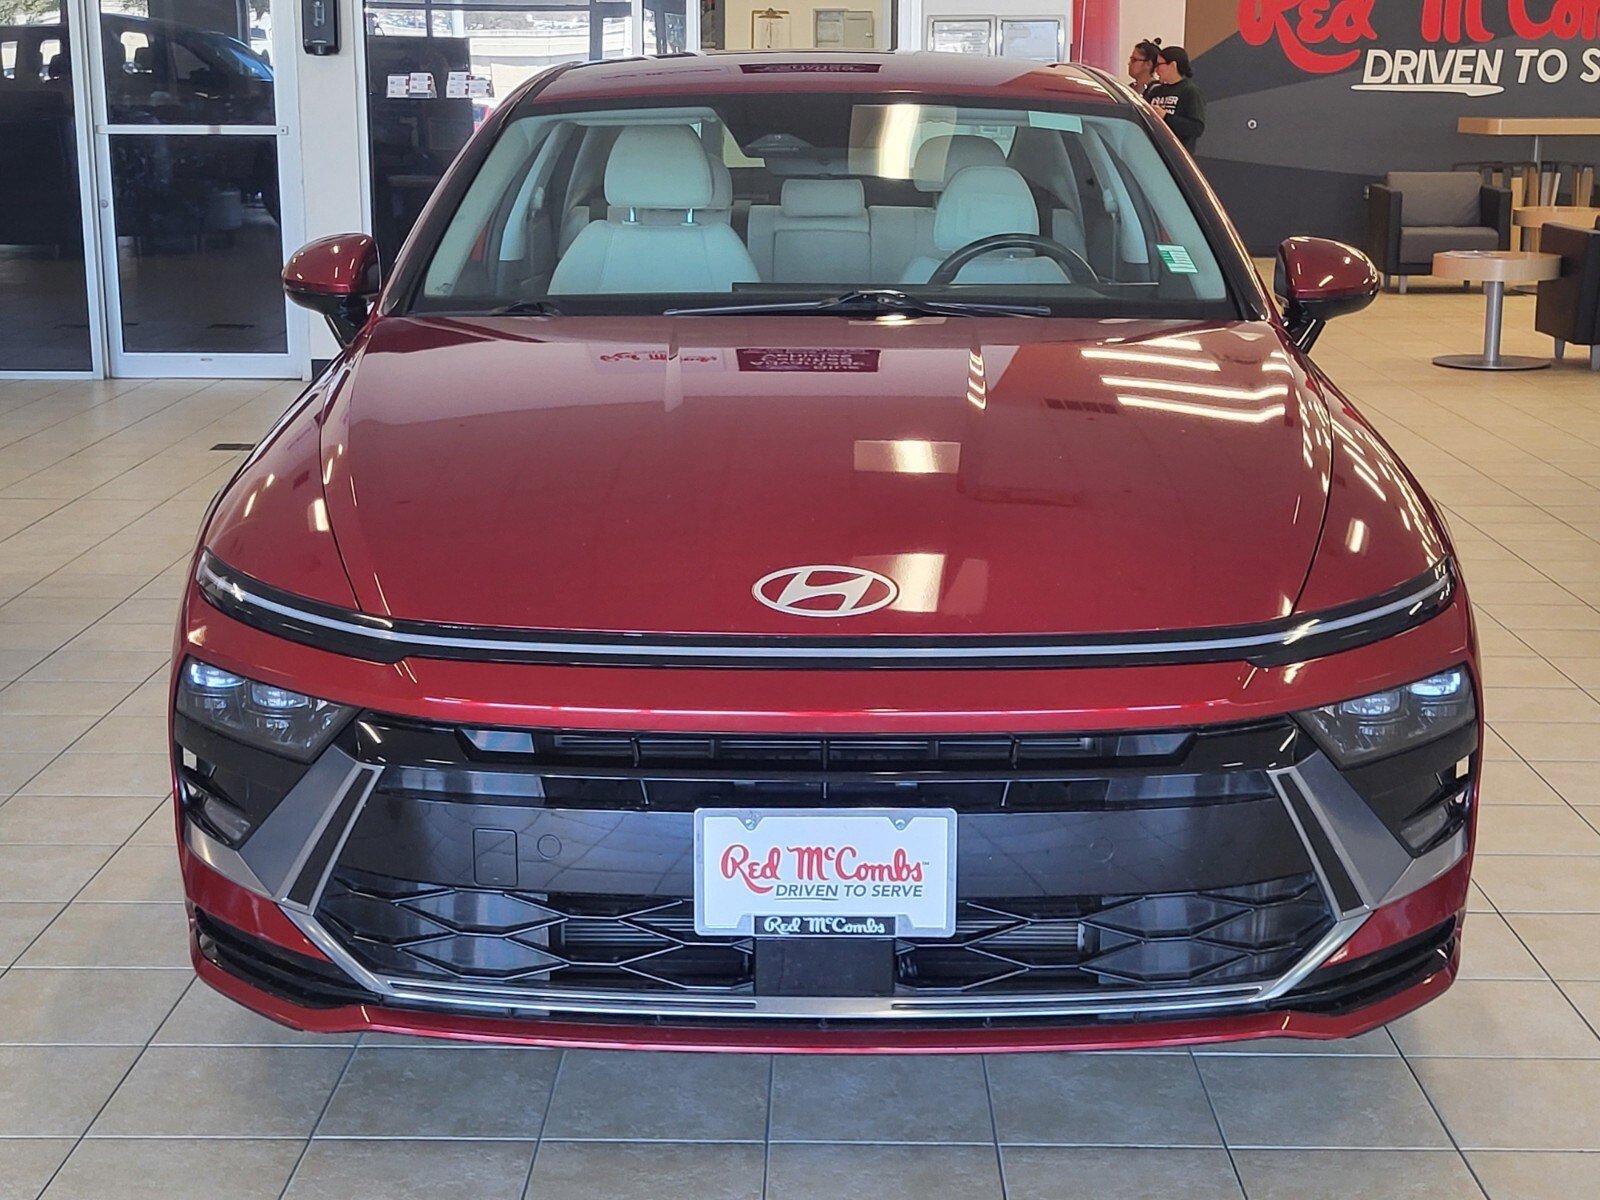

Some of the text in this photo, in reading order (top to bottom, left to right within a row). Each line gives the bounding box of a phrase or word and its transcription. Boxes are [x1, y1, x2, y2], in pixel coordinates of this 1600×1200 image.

[1362, 49, 1504, 84] DRIVEN
[1515, 48, 1569, 83] TO
[721, 844, 923, 893] Red McCombs
[775, 884, 924, 897] DRIVEN TO SERVE
[763, 916, 885, 934] Red McCombs
